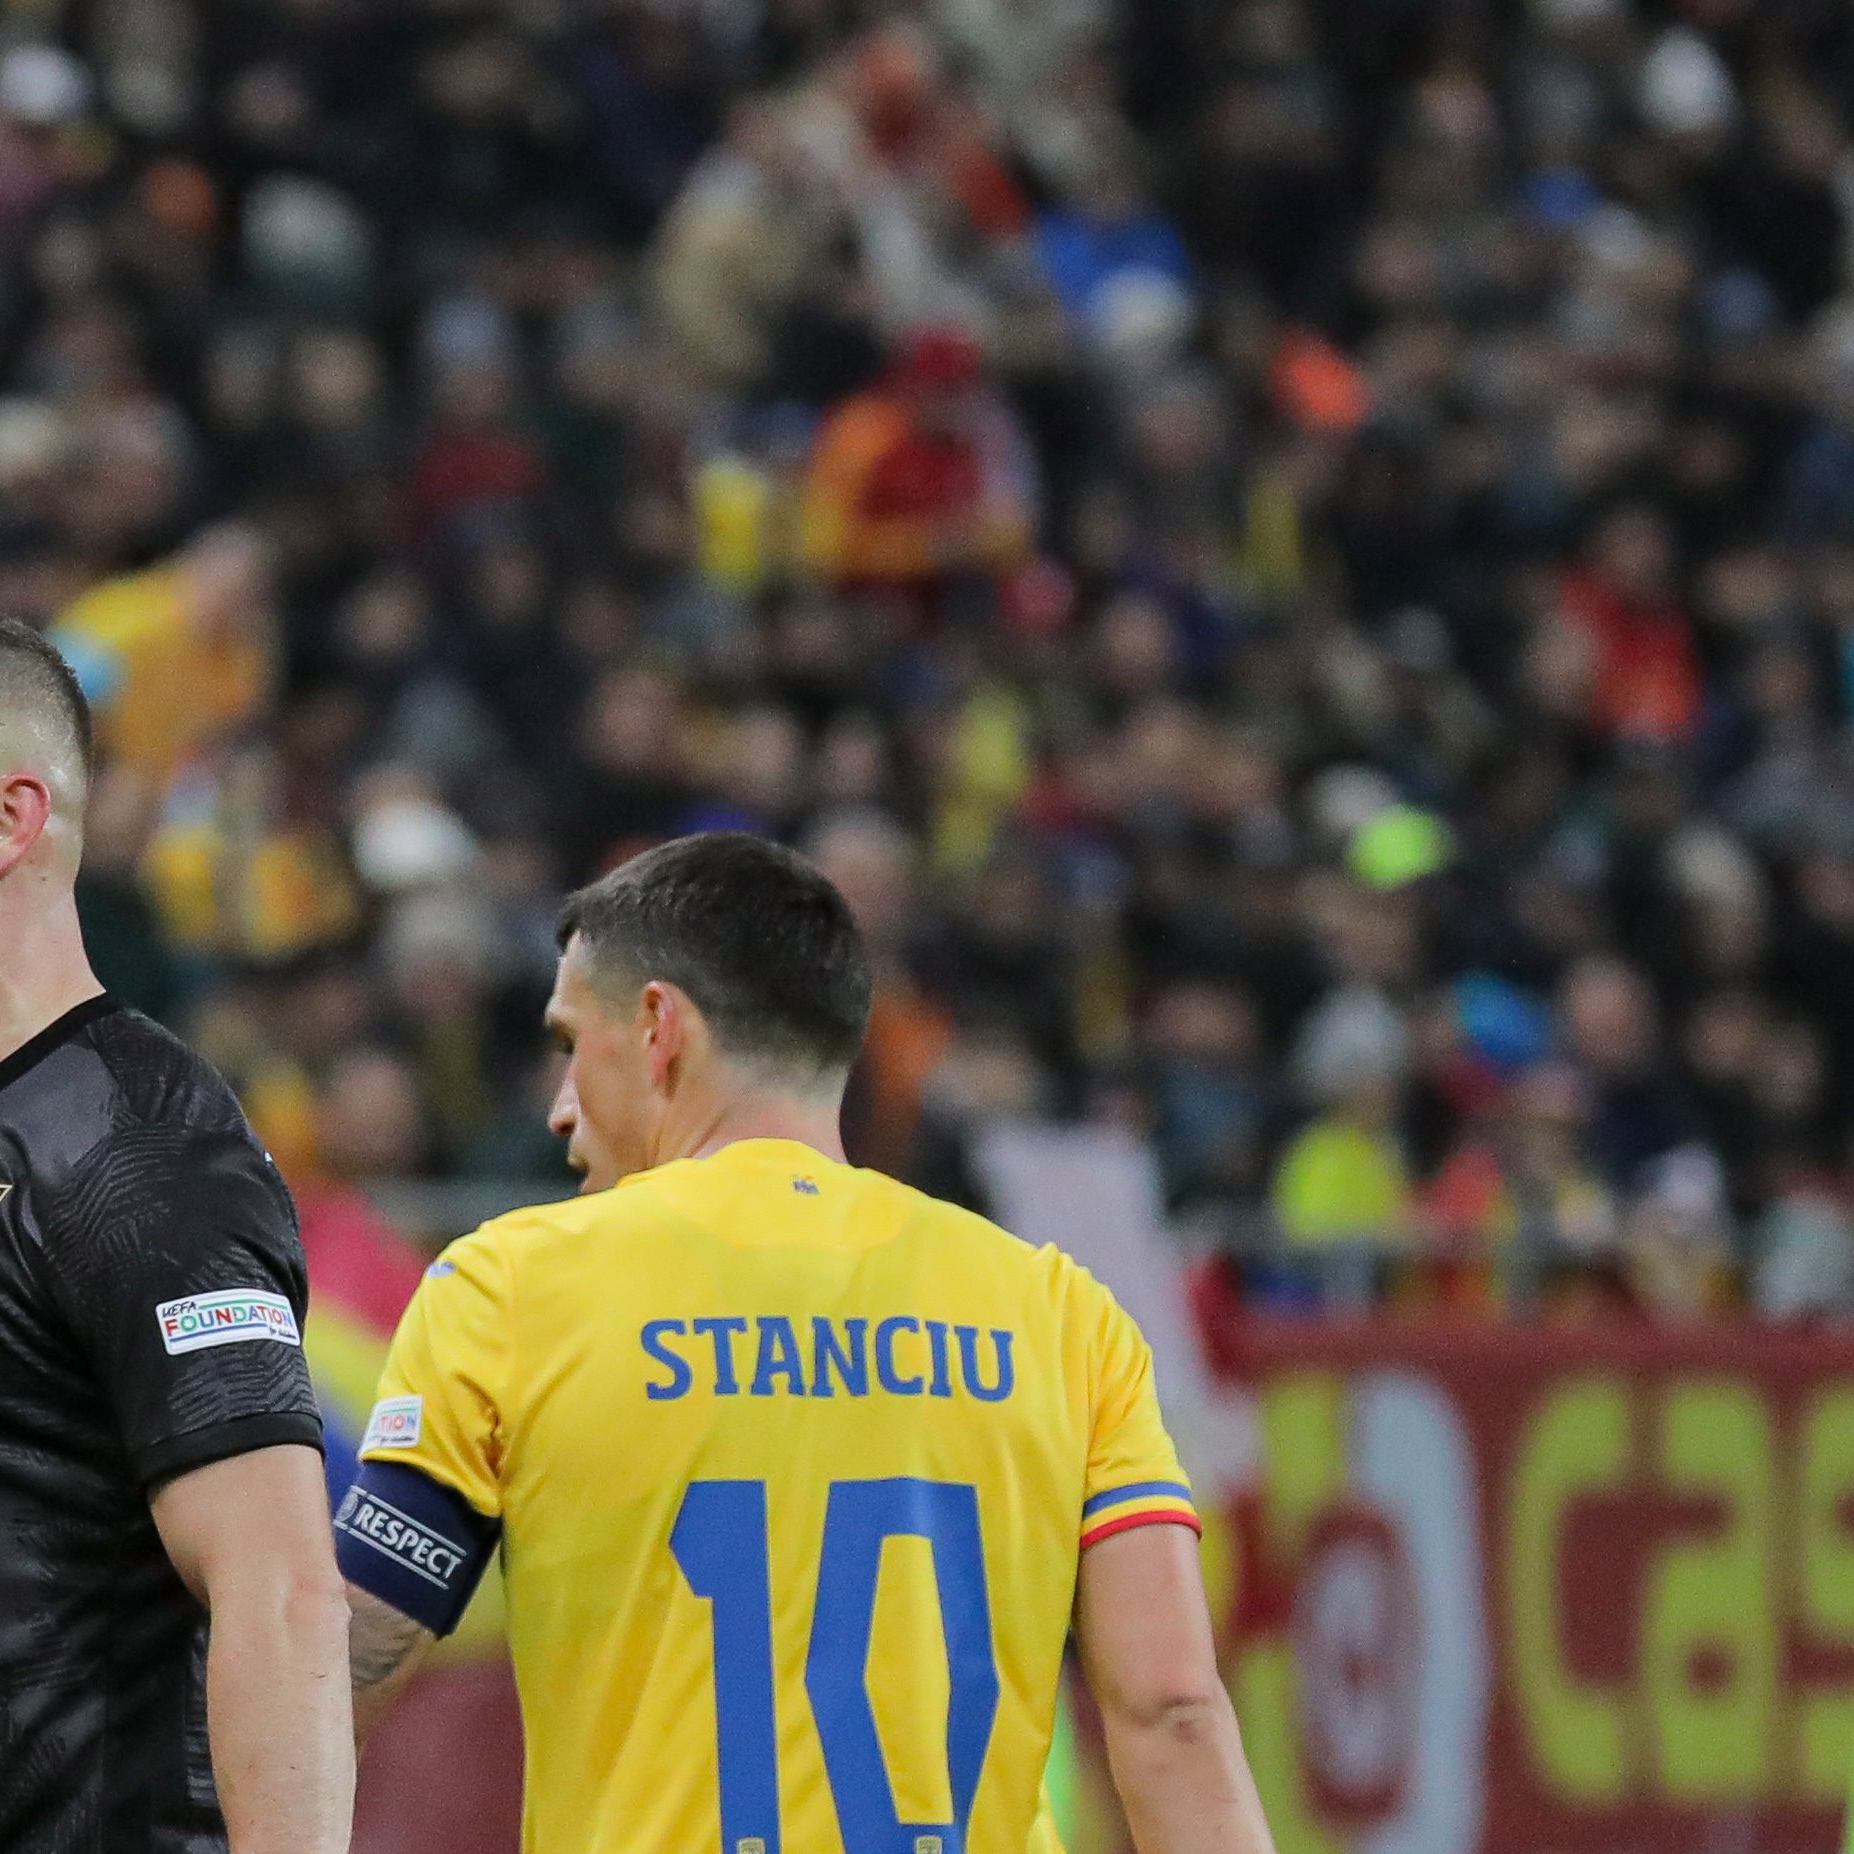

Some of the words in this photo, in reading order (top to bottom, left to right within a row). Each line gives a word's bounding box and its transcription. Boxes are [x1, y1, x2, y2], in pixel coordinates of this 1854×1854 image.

[162, 1301, 197, 1318] UEFA
[165, 1305, 293, 1337] FOUNDATION
[640, 1315, 1015, 1402] STANCIU
[354, 1502, 464, 1579] RESPECT
